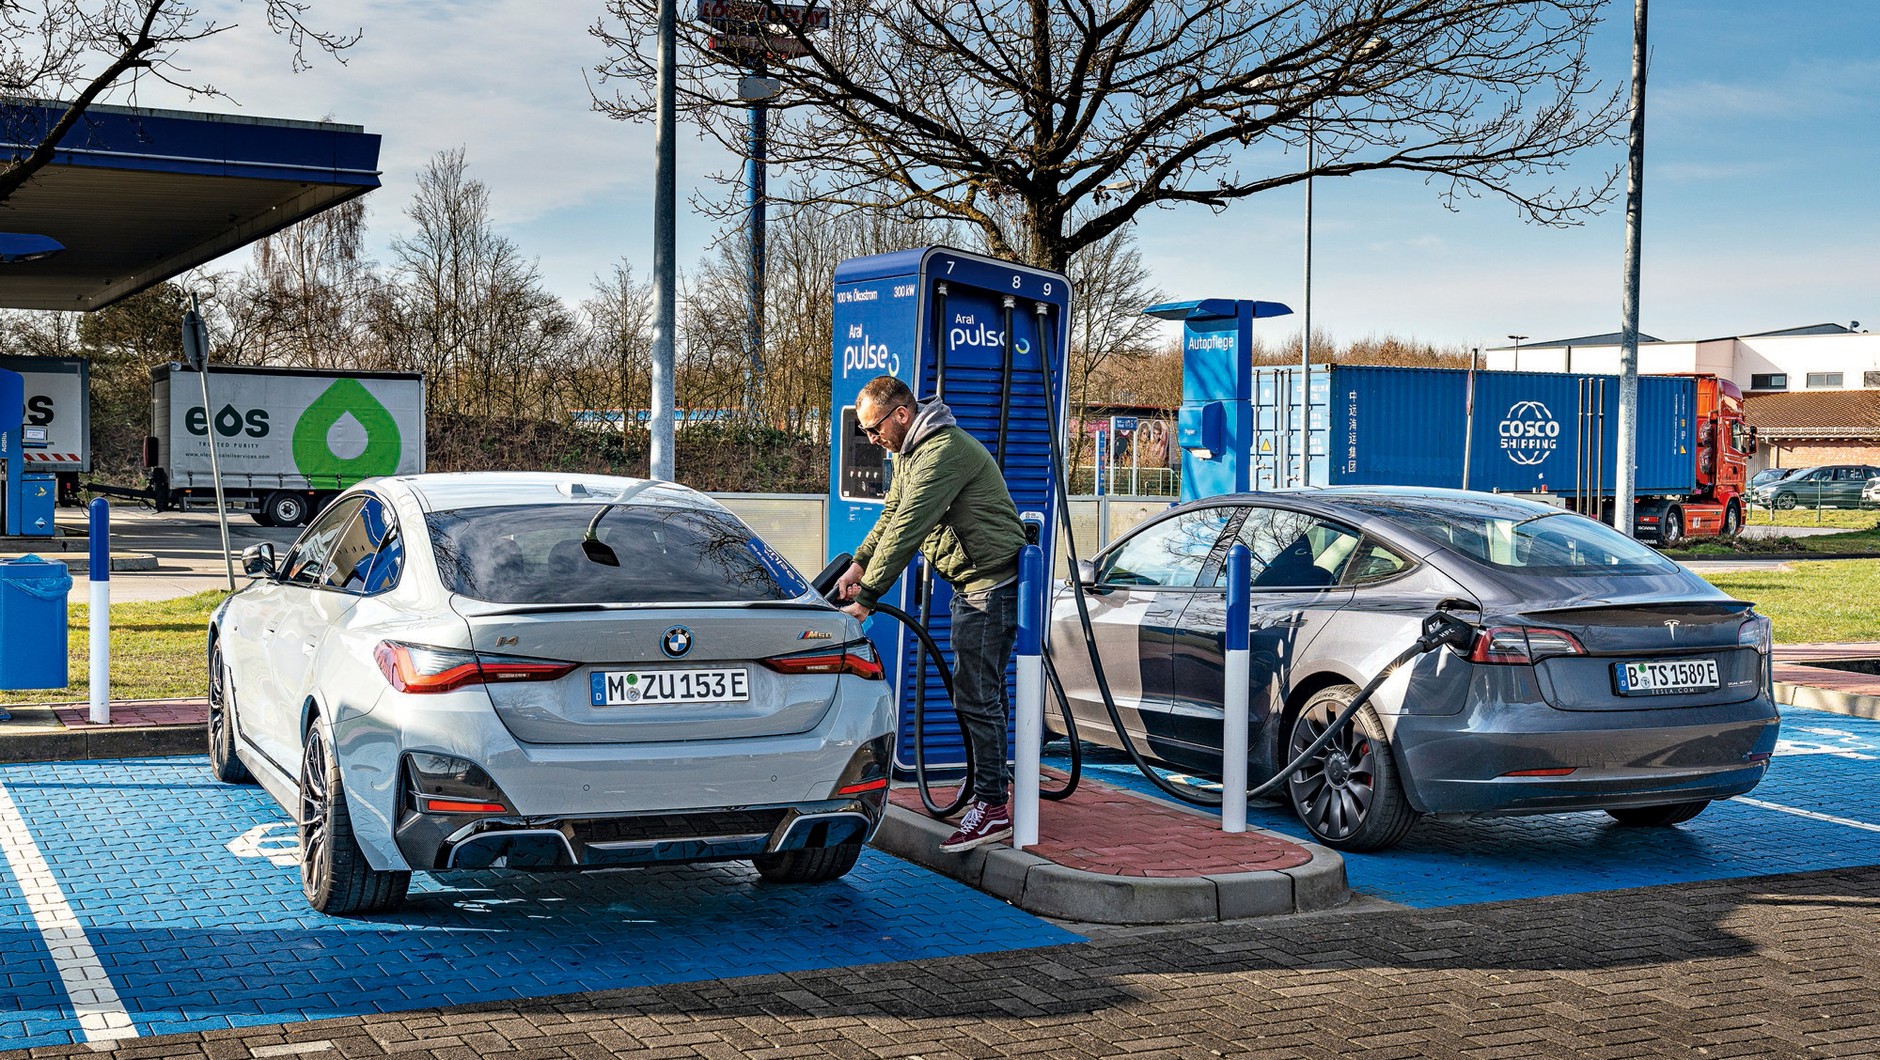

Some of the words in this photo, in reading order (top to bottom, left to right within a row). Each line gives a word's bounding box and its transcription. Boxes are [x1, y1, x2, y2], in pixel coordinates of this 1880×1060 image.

[946, 261, 955, 274] 7
[1012, 276, 1020, 288] 8
[894, 286, 904, 298] 300
[1043, 282, 1052, 296] 9
[837, 292, 846, 303] 100
[955, 314, 974, 324] Aral
[848, 324, 862, 338] Aral
[1188, 334, 1234, 352] Autopflege
[844, 334, 888, 378] pulse
[1499, 420, 1560, 437] COSCO
[1500, 438, 1556, 449] SHIPPING
